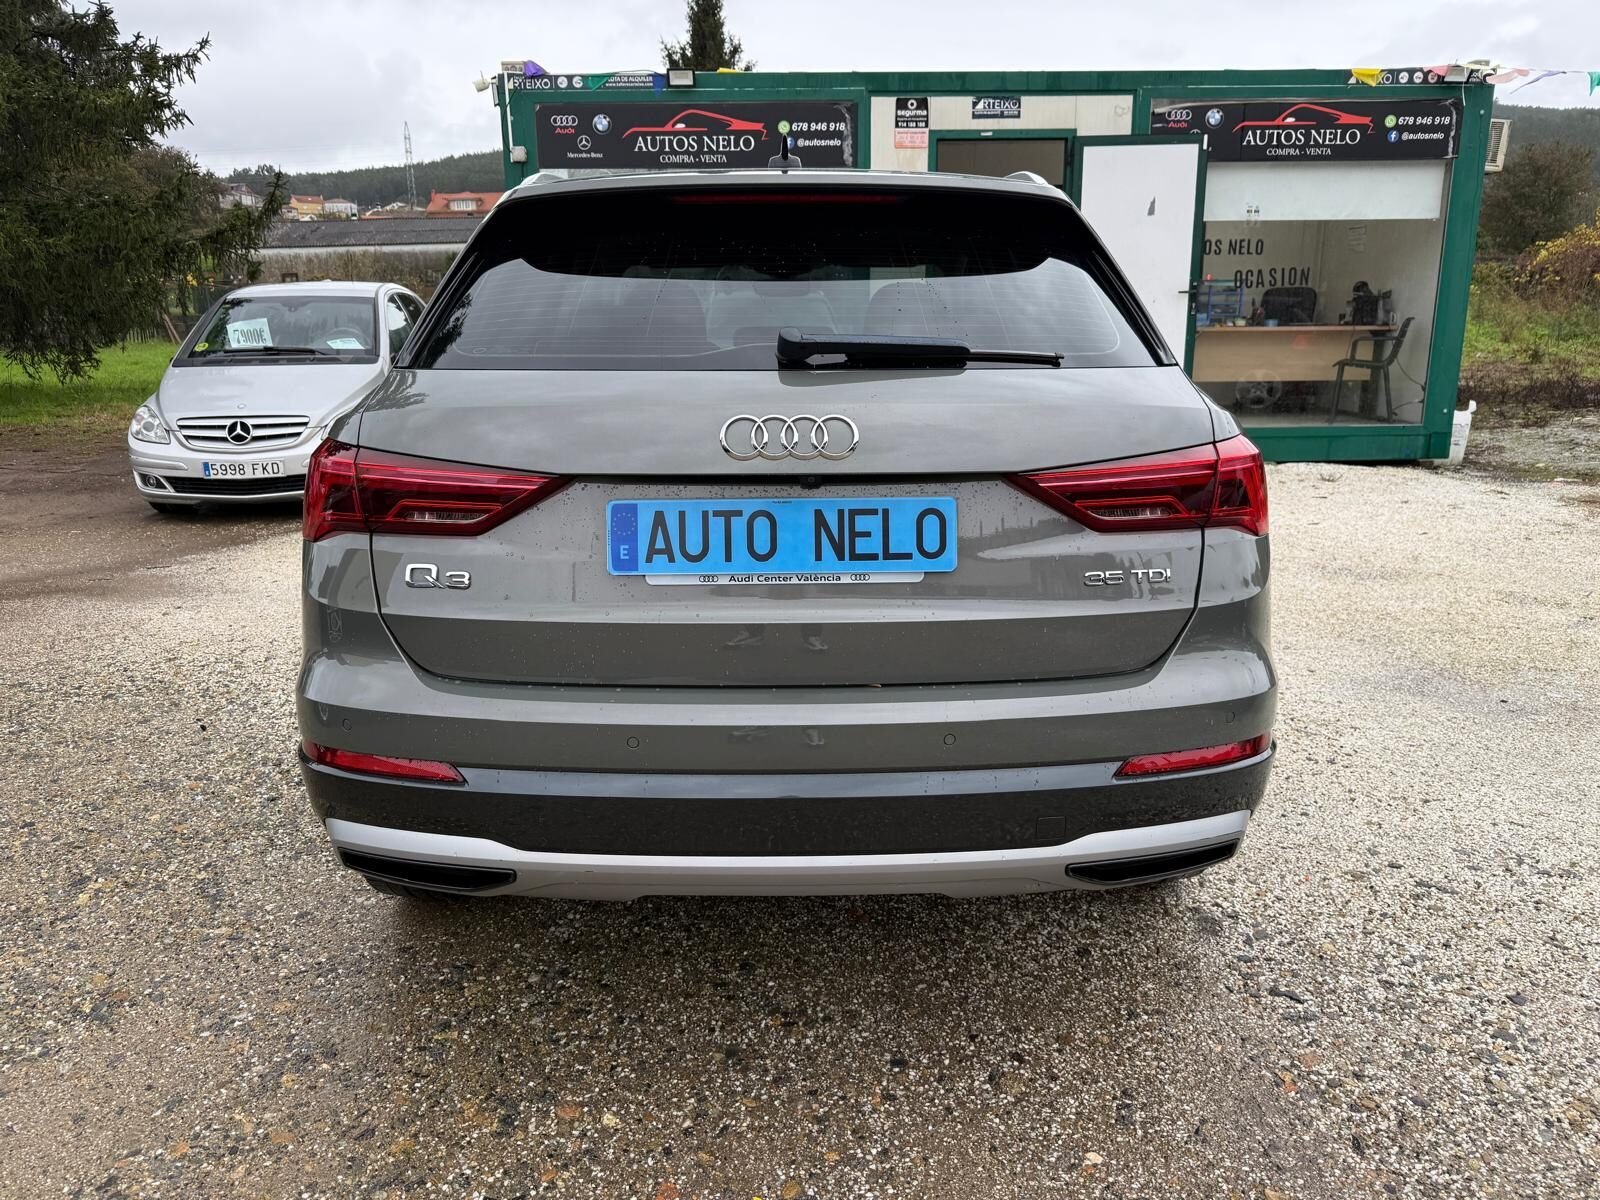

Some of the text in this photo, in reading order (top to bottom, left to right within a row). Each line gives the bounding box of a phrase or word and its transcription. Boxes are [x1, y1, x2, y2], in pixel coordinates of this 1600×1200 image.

[792, 122, 845, 131] 678 946 918
[1398, 116, 1451, 125] 678 946 918
[634, 135, 755, 151] AUTOS NELO
[797, 138, 841, 147] @autosnelo
[1242, 128, 1360, 146] AUTOS NELO
[1402, 131, 1444, 140] @autosnelo
[660, 154, 694, 163] COMPRA
[700, 154, 727, 163] VENTA
[1266, 147, 1300, 156] COMPRA
[1305, 147, 1332, 156] VENTA
[1228, 238, 1264, 255] NELO
[1234, 266, 1311, 288] OCASION
[232, 327, 267, 345] 7900€
[210, 463, 246, 476] 5998
[251, 462, 280, 476] FKD
[645, 507, 947, 563] AUTO NELO
[620, 545, 630, 560] E
[405, 563, 471, 590] Q3
[728, 572, 841, 583] Audi Center València
[1084, 568, 1171, 586] 35 TDI
